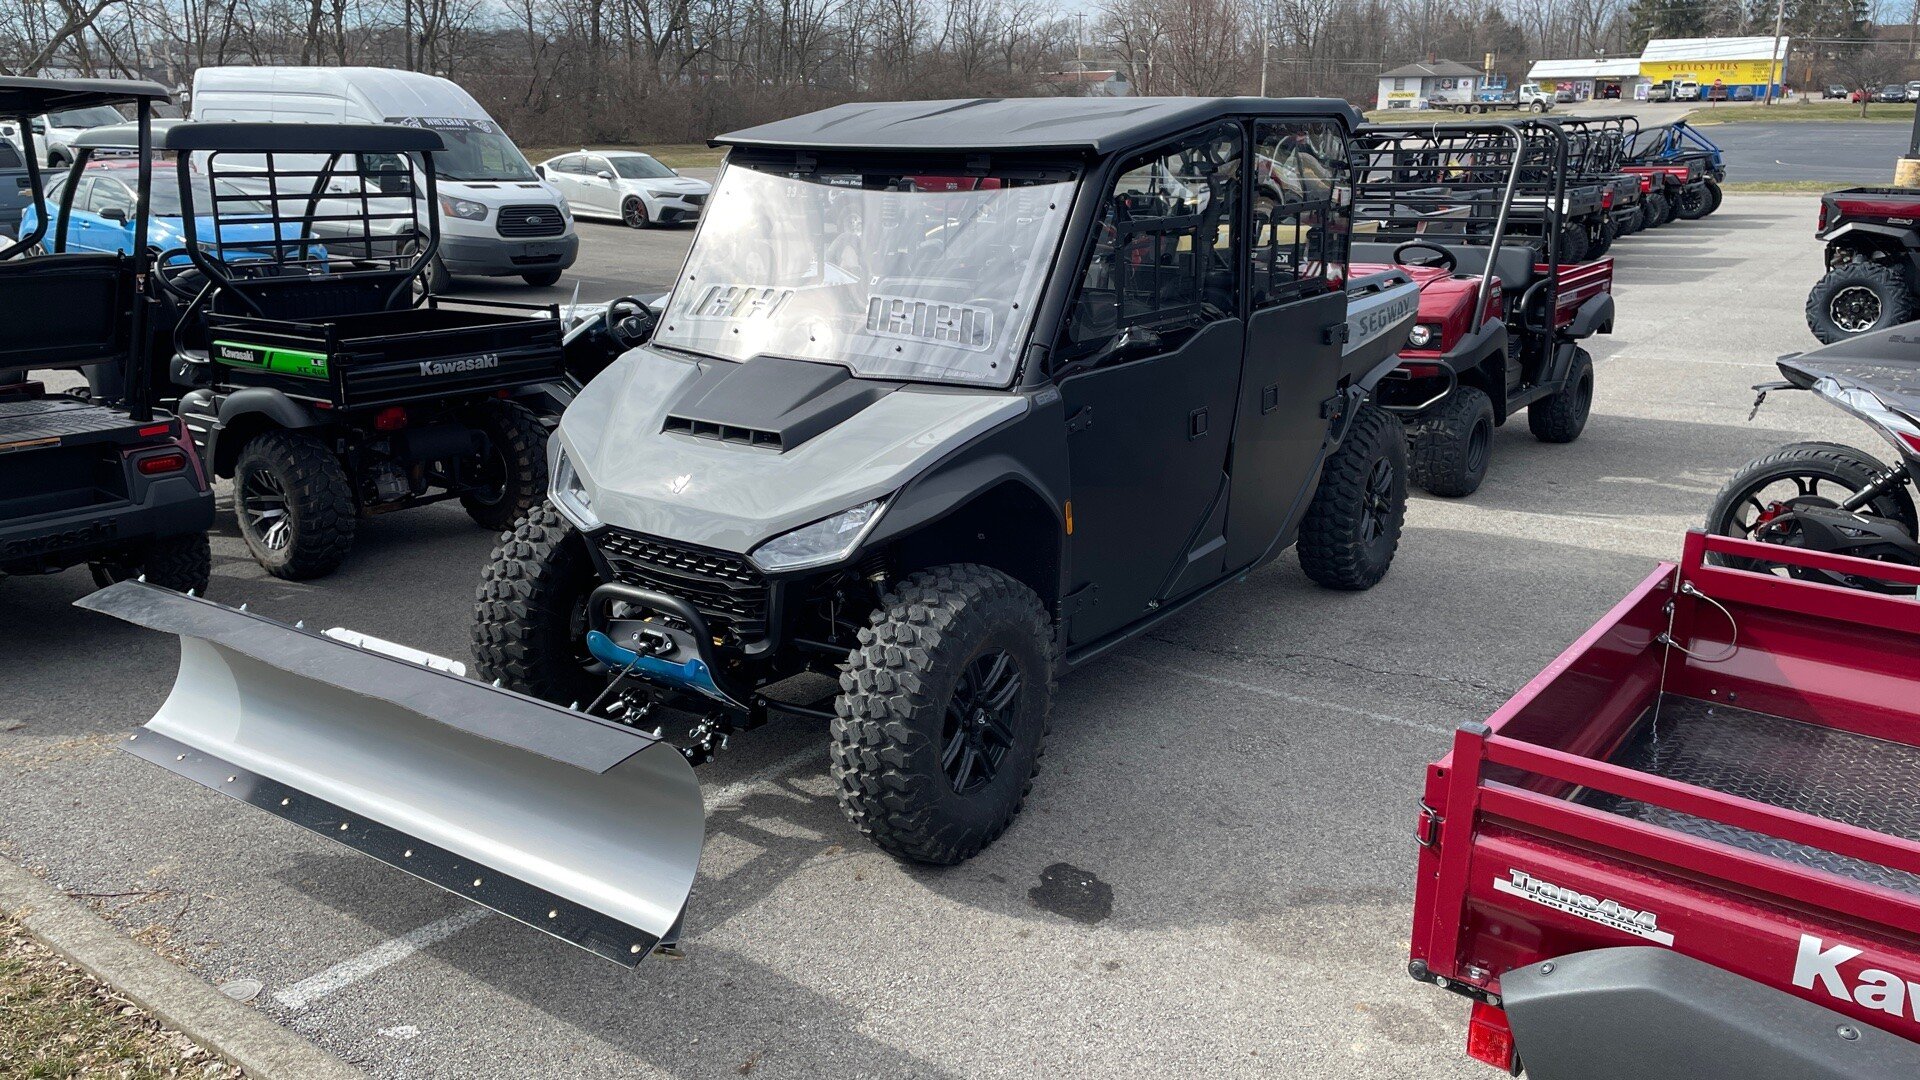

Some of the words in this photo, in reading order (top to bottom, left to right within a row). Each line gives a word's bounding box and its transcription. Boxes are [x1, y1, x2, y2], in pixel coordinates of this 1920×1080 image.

[1709, 62, 1738, 70] TIRES
[423, 117, 470, 127] WHITCRAFT
[1359, 297, 1410, 337] SEGWAY
[221, 347, 254, 362] Kawasaki
[310, 359, 325, 367] LE
[419, 353, 498, 376] Kawasaki
[1509, 868, 1657, 933] Trans4x4
[1528, 894, 1563, 909] Fuel
[1568, 906, 1643, 936] Injection
